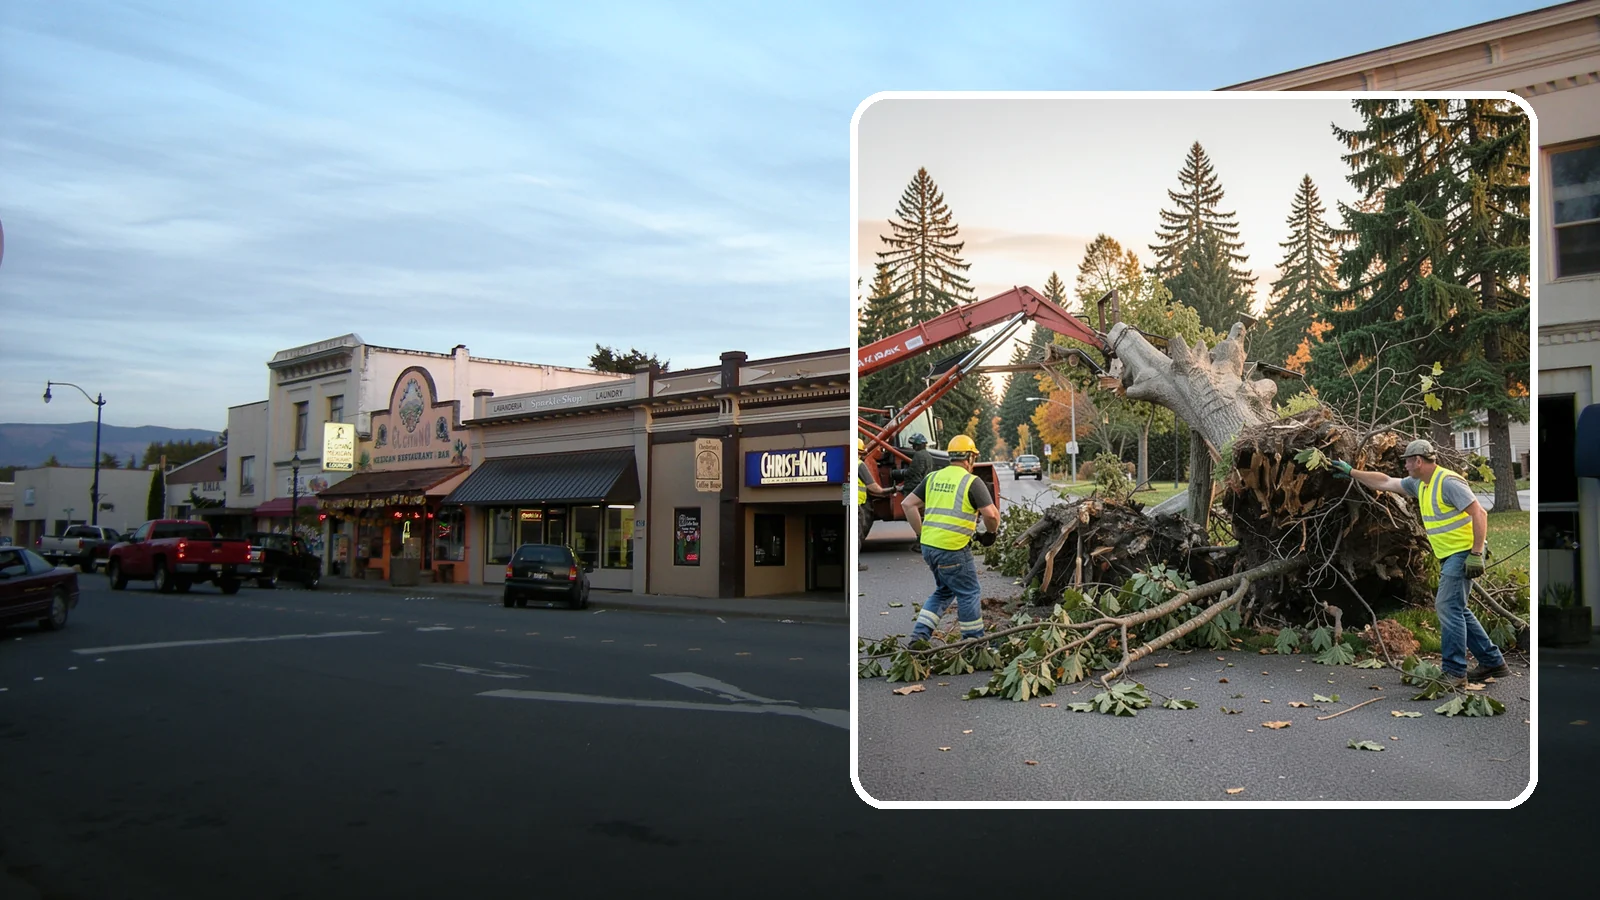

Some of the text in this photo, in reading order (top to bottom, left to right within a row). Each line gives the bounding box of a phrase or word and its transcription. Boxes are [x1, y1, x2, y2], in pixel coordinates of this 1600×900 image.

[493, 402, 522, 413] LAVANDERIA
[561, 394, 582, 405] Shop
[595, 389, 624, 400] LAUNDRY
[398, 451, 433, 462] RESTAURANT
[437, 450, 450, 459] BAR
[799, 450, 827, 476] KING
